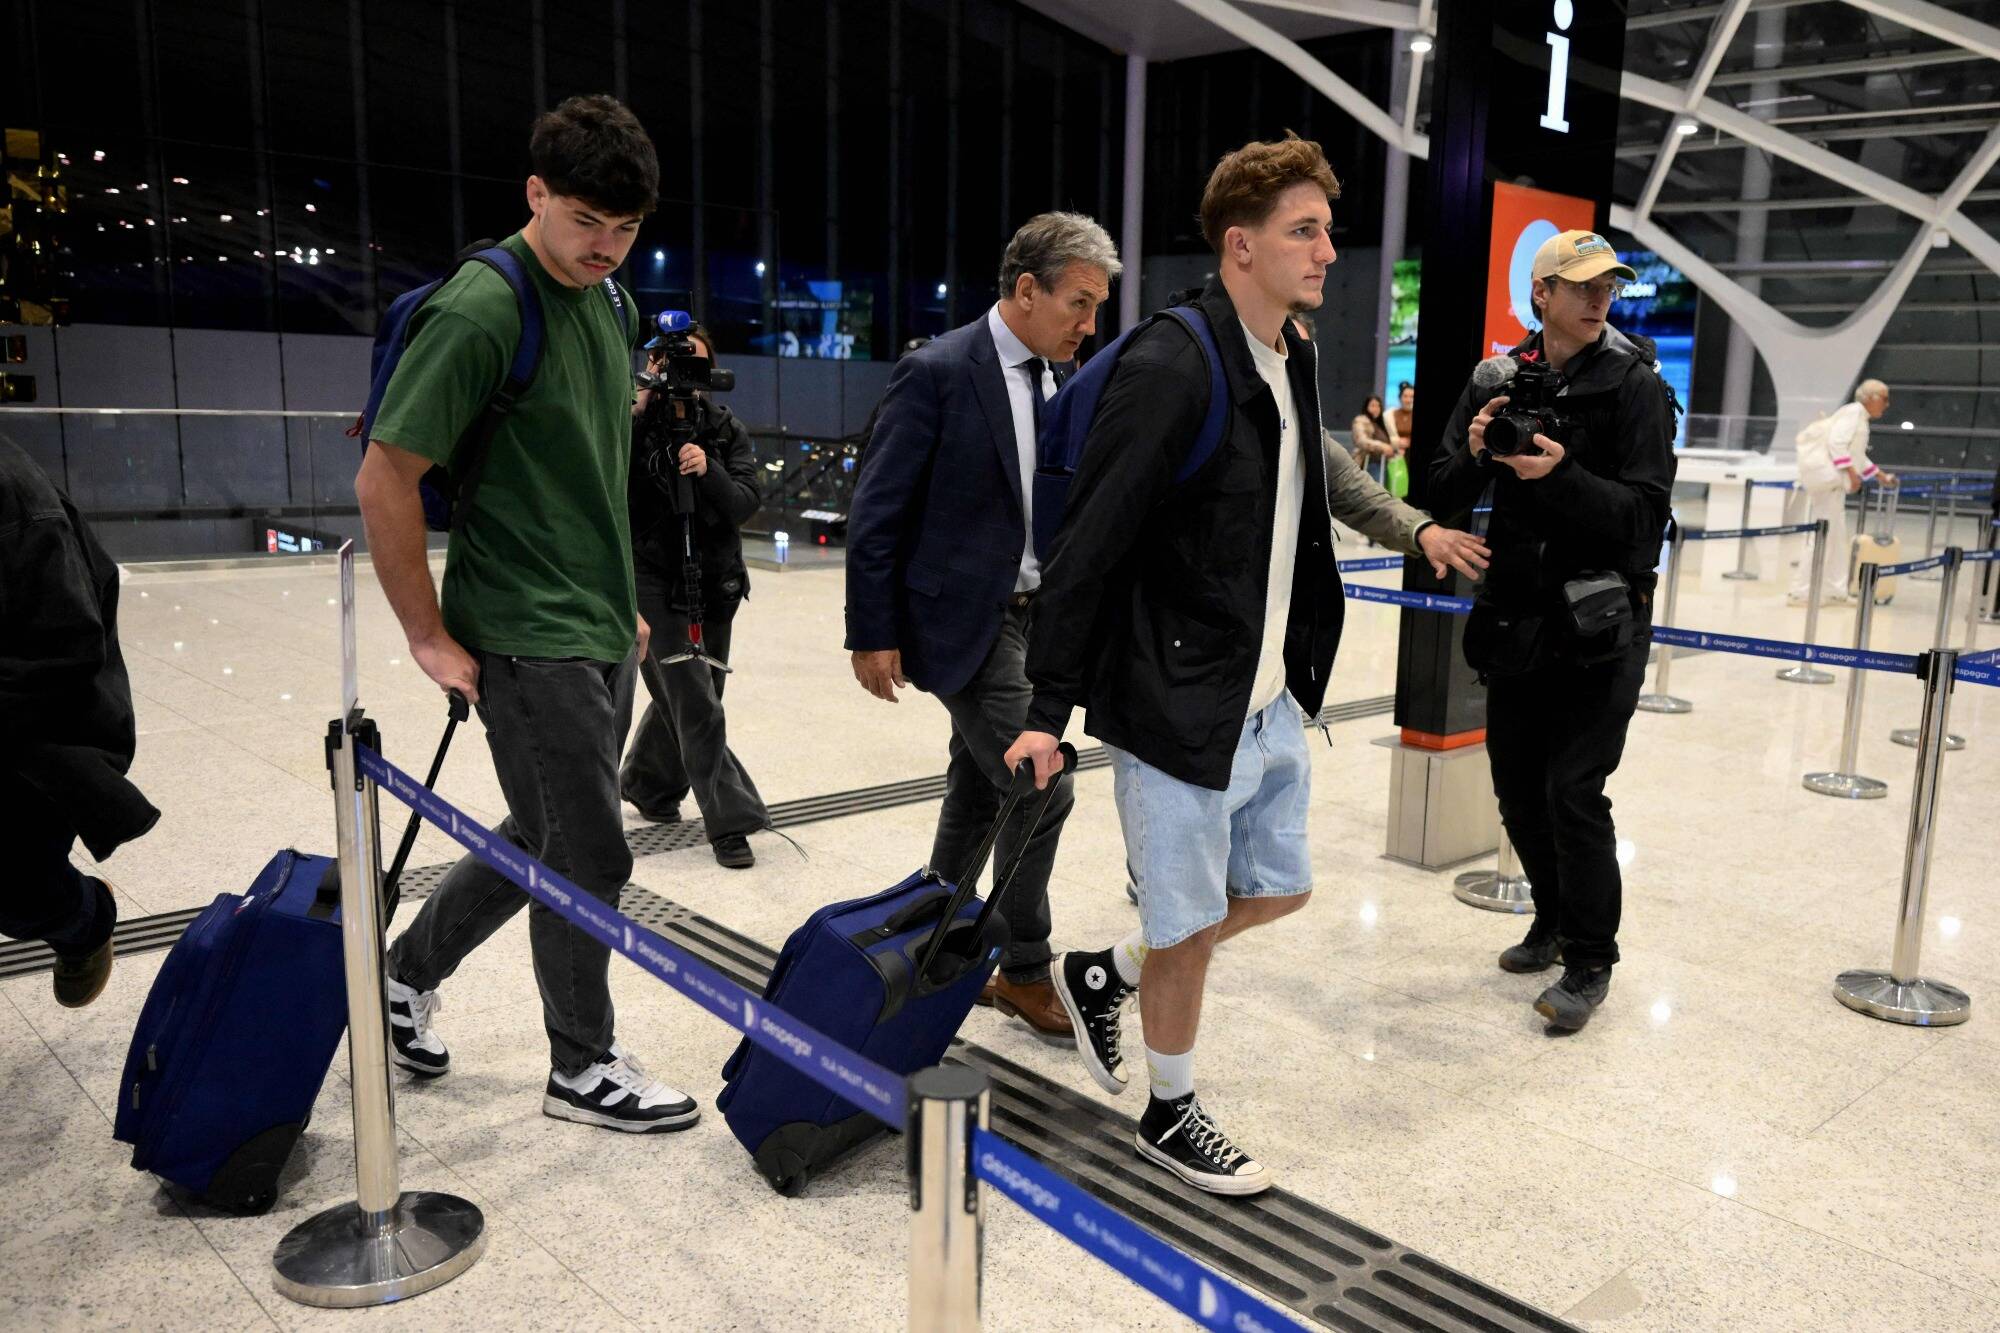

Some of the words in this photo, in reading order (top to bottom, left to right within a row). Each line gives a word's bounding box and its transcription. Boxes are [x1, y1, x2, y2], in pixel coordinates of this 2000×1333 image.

[1540, 0, 1573, 134] i
[1713, 637, 1748, 650] despegar
[1818, 650, 1858, 662] despegar
[1955, 667, 1990, 680] espegar
[760, 1016, 813, 1057] despegar
[981, 1152, 1061, 1213] despegar
